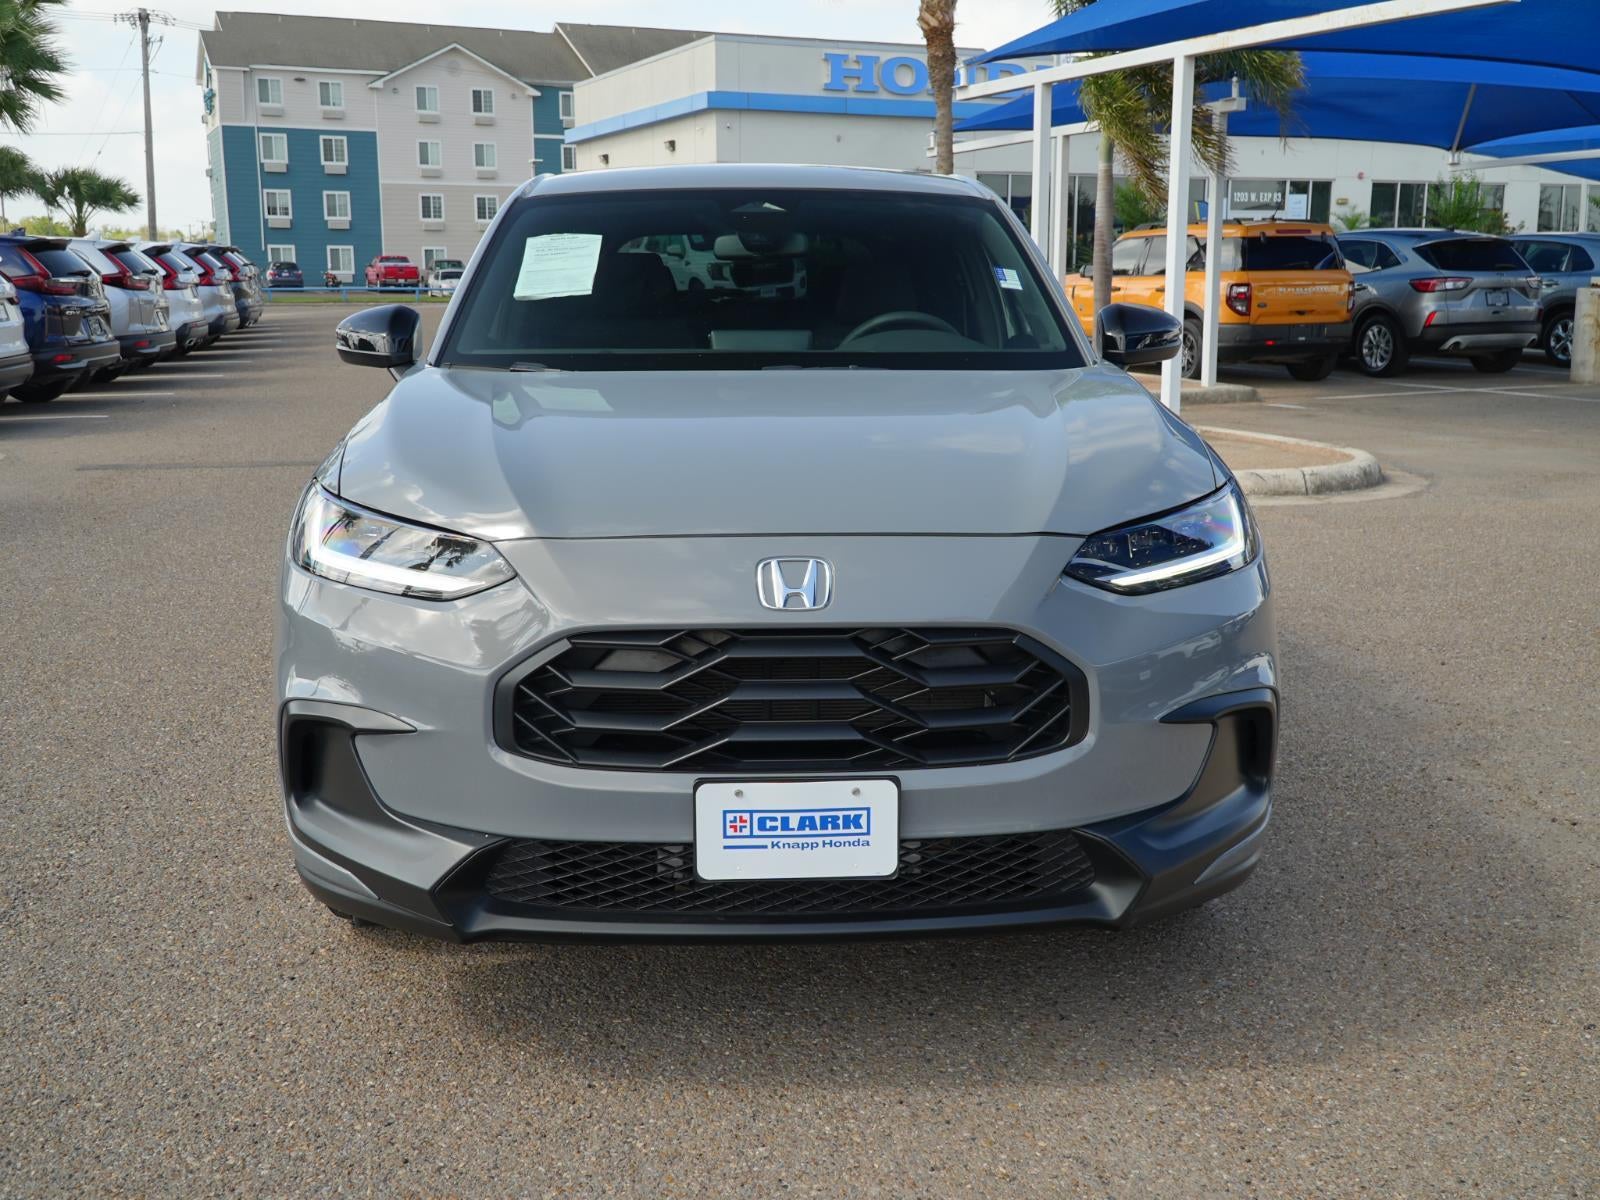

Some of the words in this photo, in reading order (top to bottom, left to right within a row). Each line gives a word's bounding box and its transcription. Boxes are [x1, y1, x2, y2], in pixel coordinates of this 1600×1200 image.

[823, 53, 1054, 98] HOD
[1233, 191, 1249, 202] 1203
[1260, 191, 1272, 202] EXP
[1273, 191, 1282, 202] 83
[757, 813, 864, 832] CLARK
[770, 840, 820, 851] Knapp
[822, 838, 871, 848] Honda
